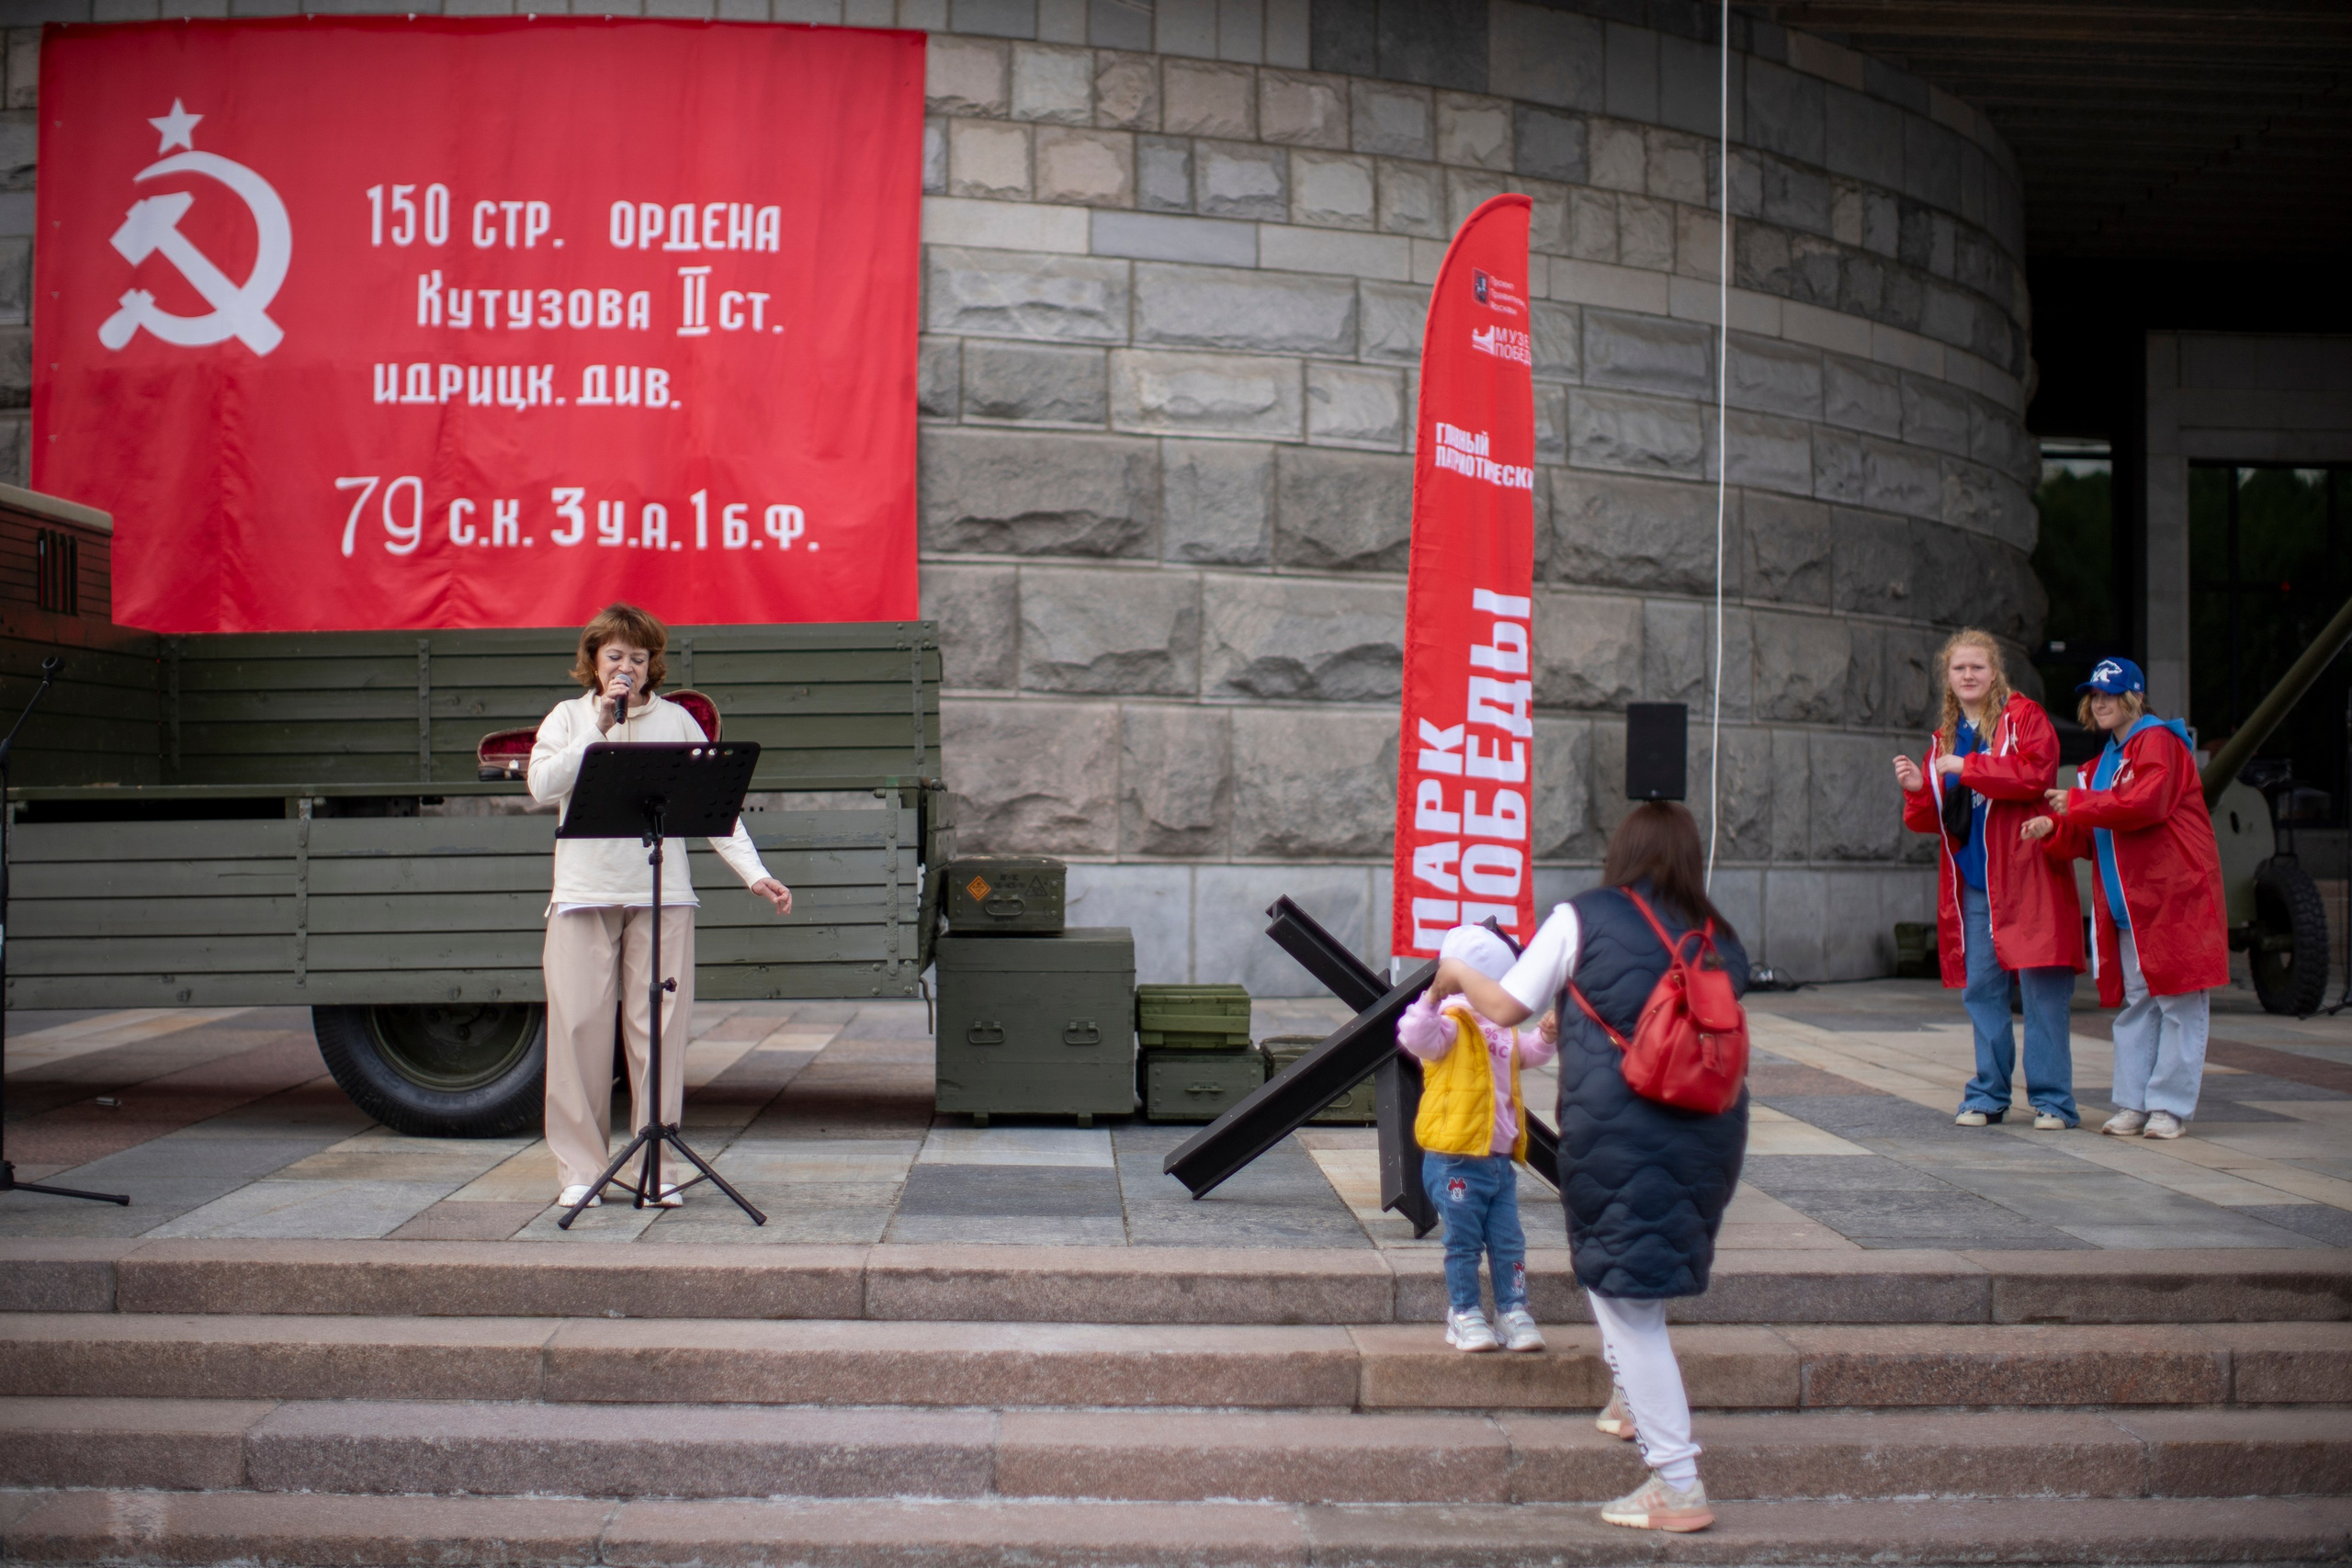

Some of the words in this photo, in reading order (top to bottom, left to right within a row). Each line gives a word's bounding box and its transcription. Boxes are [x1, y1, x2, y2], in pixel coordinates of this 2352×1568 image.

[367, 183, 449, 246] 150
[472, 199, 564, 249] СТР.
[609, 199, 781, 253] ОРДЕНА
[718, 289, 785, 334] СТ.
[373, 362, 566, 412] ИДРИЦК.
[575, 364, 682, 410] ДИВ.
[334, 475, 423, 557] 79
[550, 486, 585, 547] 3
[1411, 717, 1465, 951] ПАРК
